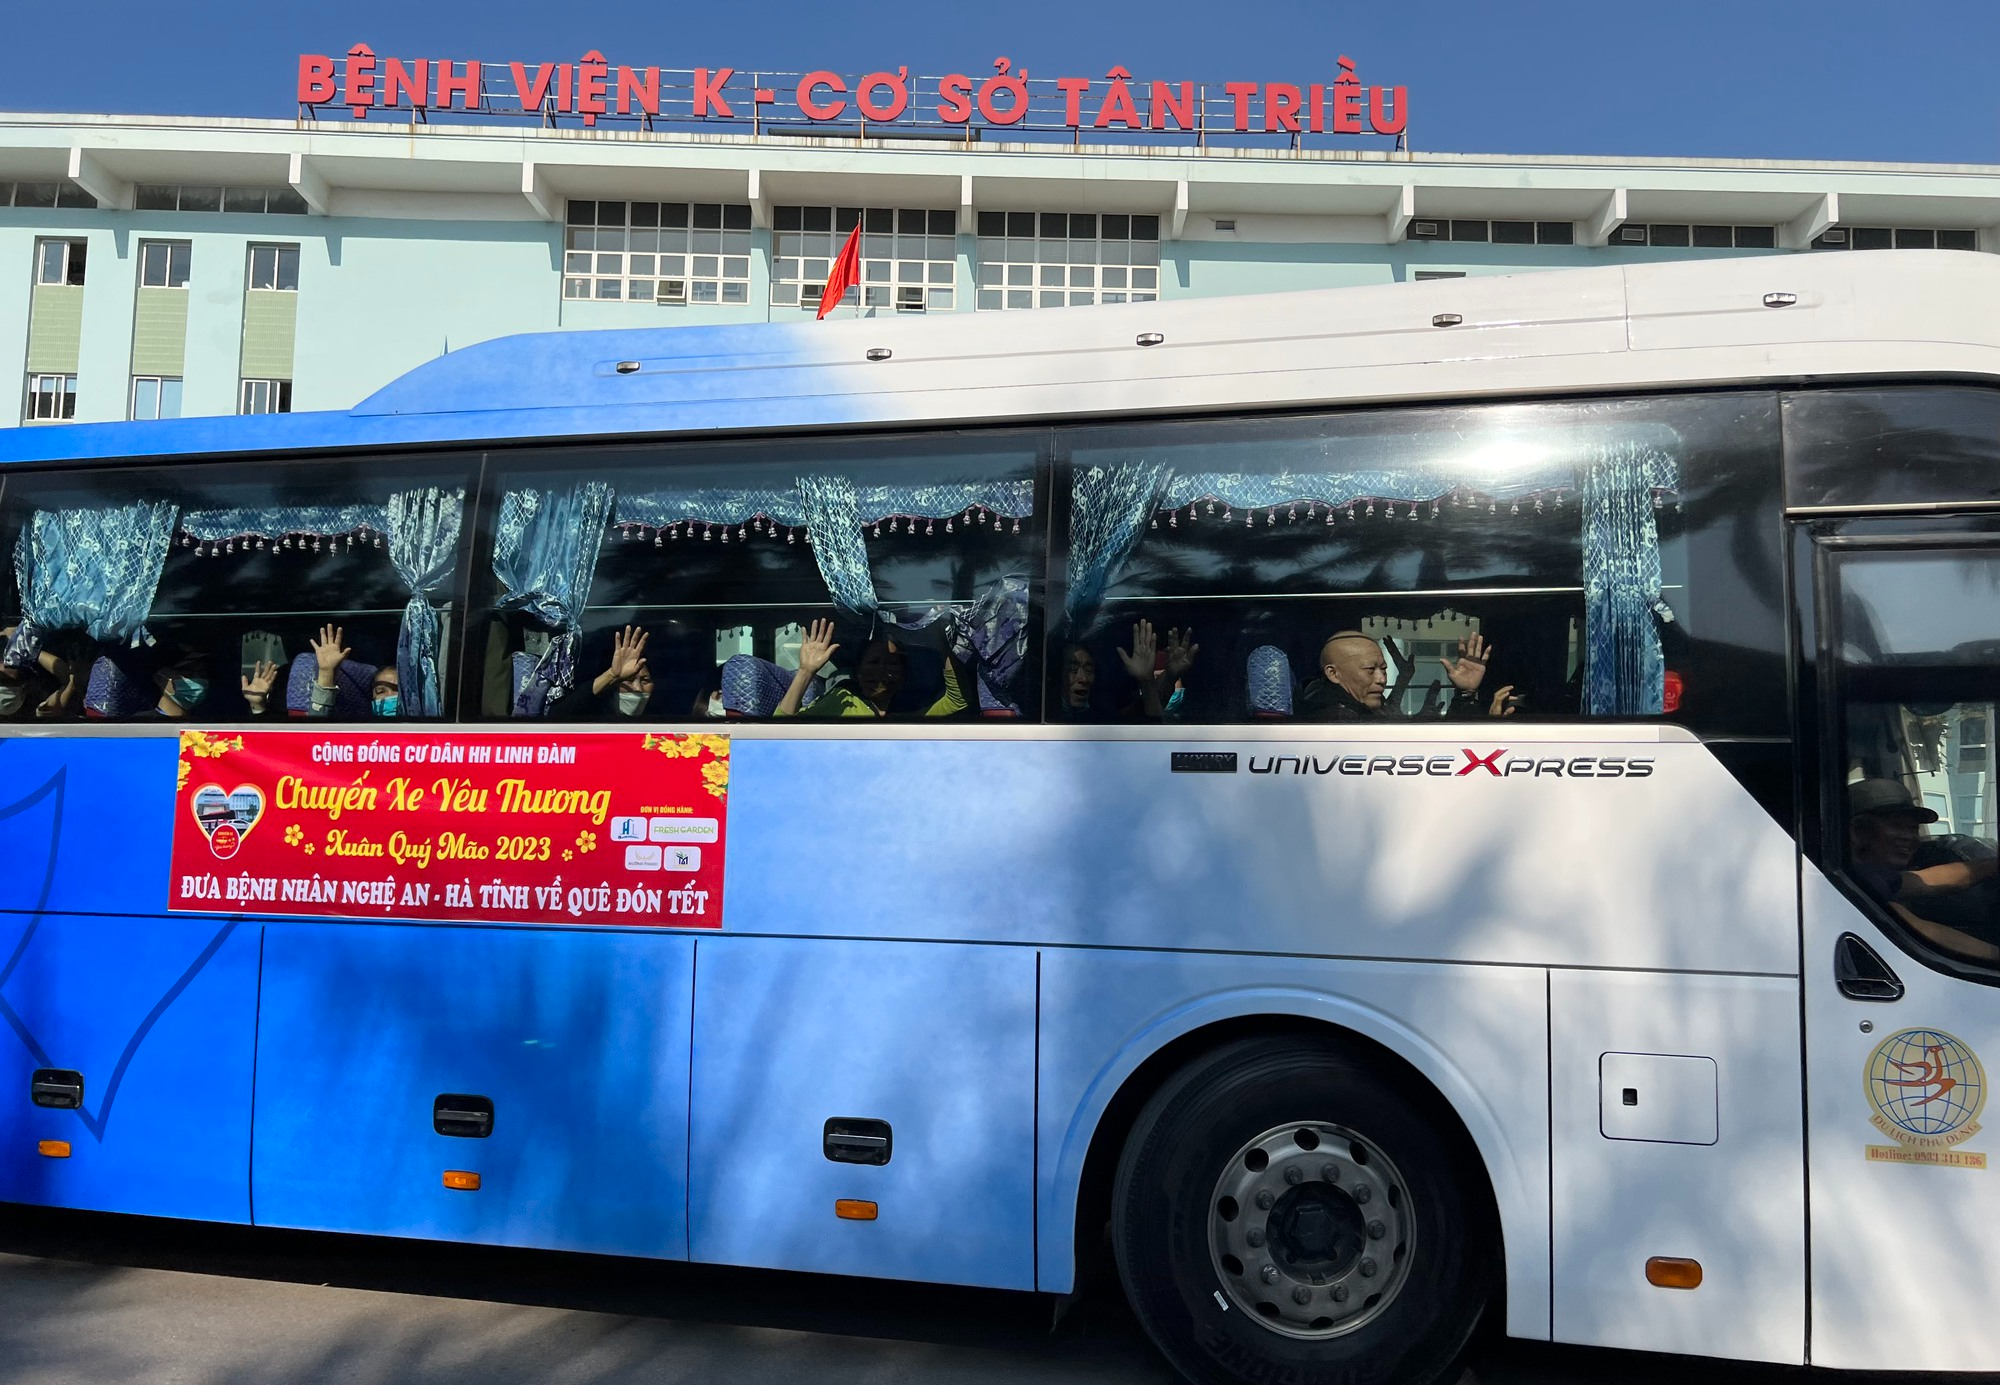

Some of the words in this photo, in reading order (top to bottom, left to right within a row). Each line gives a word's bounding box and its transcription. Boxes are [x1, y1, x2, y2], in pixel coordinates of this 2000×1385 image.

[298, 43, 481, 119] BỆNH
[510, 49, 660, 127] VIỆN
[693, 68, 734, 118] K
[796, 66, 907, 121] CƠ
[937, 57, 1028, 126] SỞ
[1057, 65, 1195, 130] TÂN
[1225, 54, 1407, 135] TRIỀU
[312, 742, 354, 765] CỘNG
[357, 740, 400, 763] ĐỒNG
[404, 744, 429, 763] CƯ
[430, 742, 464, 764] DÂN
[468, 746, 491, 764] HH
[495, 746, 534, 764] LINH
[537, 743, 576, 764] ĐÀM
[275, 770, 378, 820] Chuyến
[386, 777, 425, 811] Xe
[431, 778, 489, 812] Yêu
[496, 779, 611, 825] Thương
[325, 829, 384, 857] Xuân
[388, 830, 432, 869] Quý
[436, 831, 489, 860] Mão
[495, 836, 551, 861] 2023
[654, 826, 679, 834] FRESH
[680, 826, 714, 834] GARDEN
[181, 872, 221, 899] ĐƯA
[226, 871, 277, 906] BỆNH
[281, 873, 338, 903] NHÂN
[341, 875, 396, 911] NGHỆ
[400, 883, 430, 907] AN
[444, 878, 474, 908] HÀ
[479, 878, 530, 910] TĨNH
[534, 875, 563, 911] VỀ
[567, 881, 611, 917] QUÊ
[616, 882, 663, 914] ĐÓN
[668, 880, 709, 914] TẾT
[1874, 1115, 1888, 1131] DU
